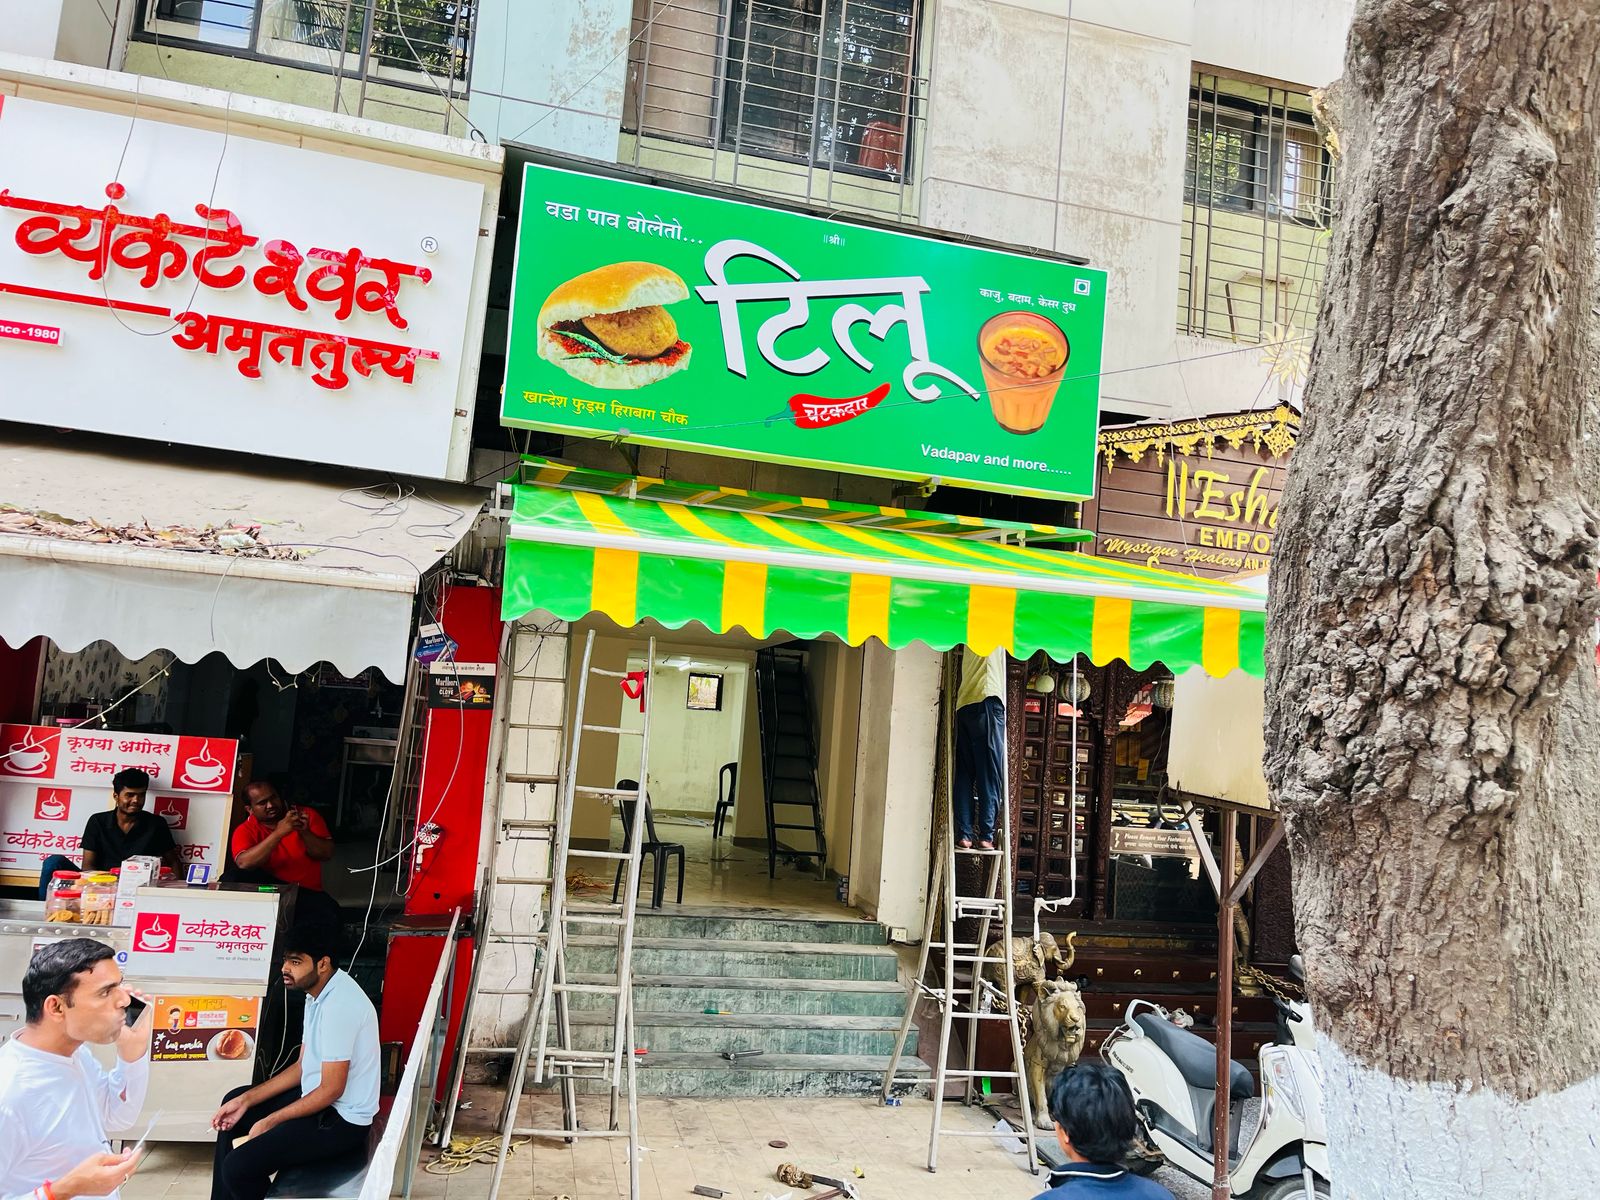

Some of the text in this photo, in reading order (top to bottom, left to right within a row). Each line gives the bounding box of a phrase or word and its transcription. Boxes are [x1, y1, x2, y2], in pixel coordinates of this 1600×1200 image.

[545, 201, 580, 221] वडा
[586, 208, 621, 228] पाव
[1037, 294, 1059, 309] केसर
[694, 239, 981, 402] टिलू
[172, 312, 441, 390] अमृततुल्य
[523, 390, 568, 408] खान्देश
[611, 400, 656, 419] हिराबाग
[660, 408, 689, 425] चौक
[802, 397, 868, 422] चटकदार
[920, 443, 981, 464] Vadapav
[983, 455, 1010, 467] and
[1103, 538, 1178, 558] Mystique
[1183, 548, 1242, 568] Healers
[1200, 526, 1270, 554] EMPO
[67, 736, 171, 756] कृपया अगोदर
[70, 757, 116, 774] टोकन
[216, 941, 268, 953] अमृततुल्य
